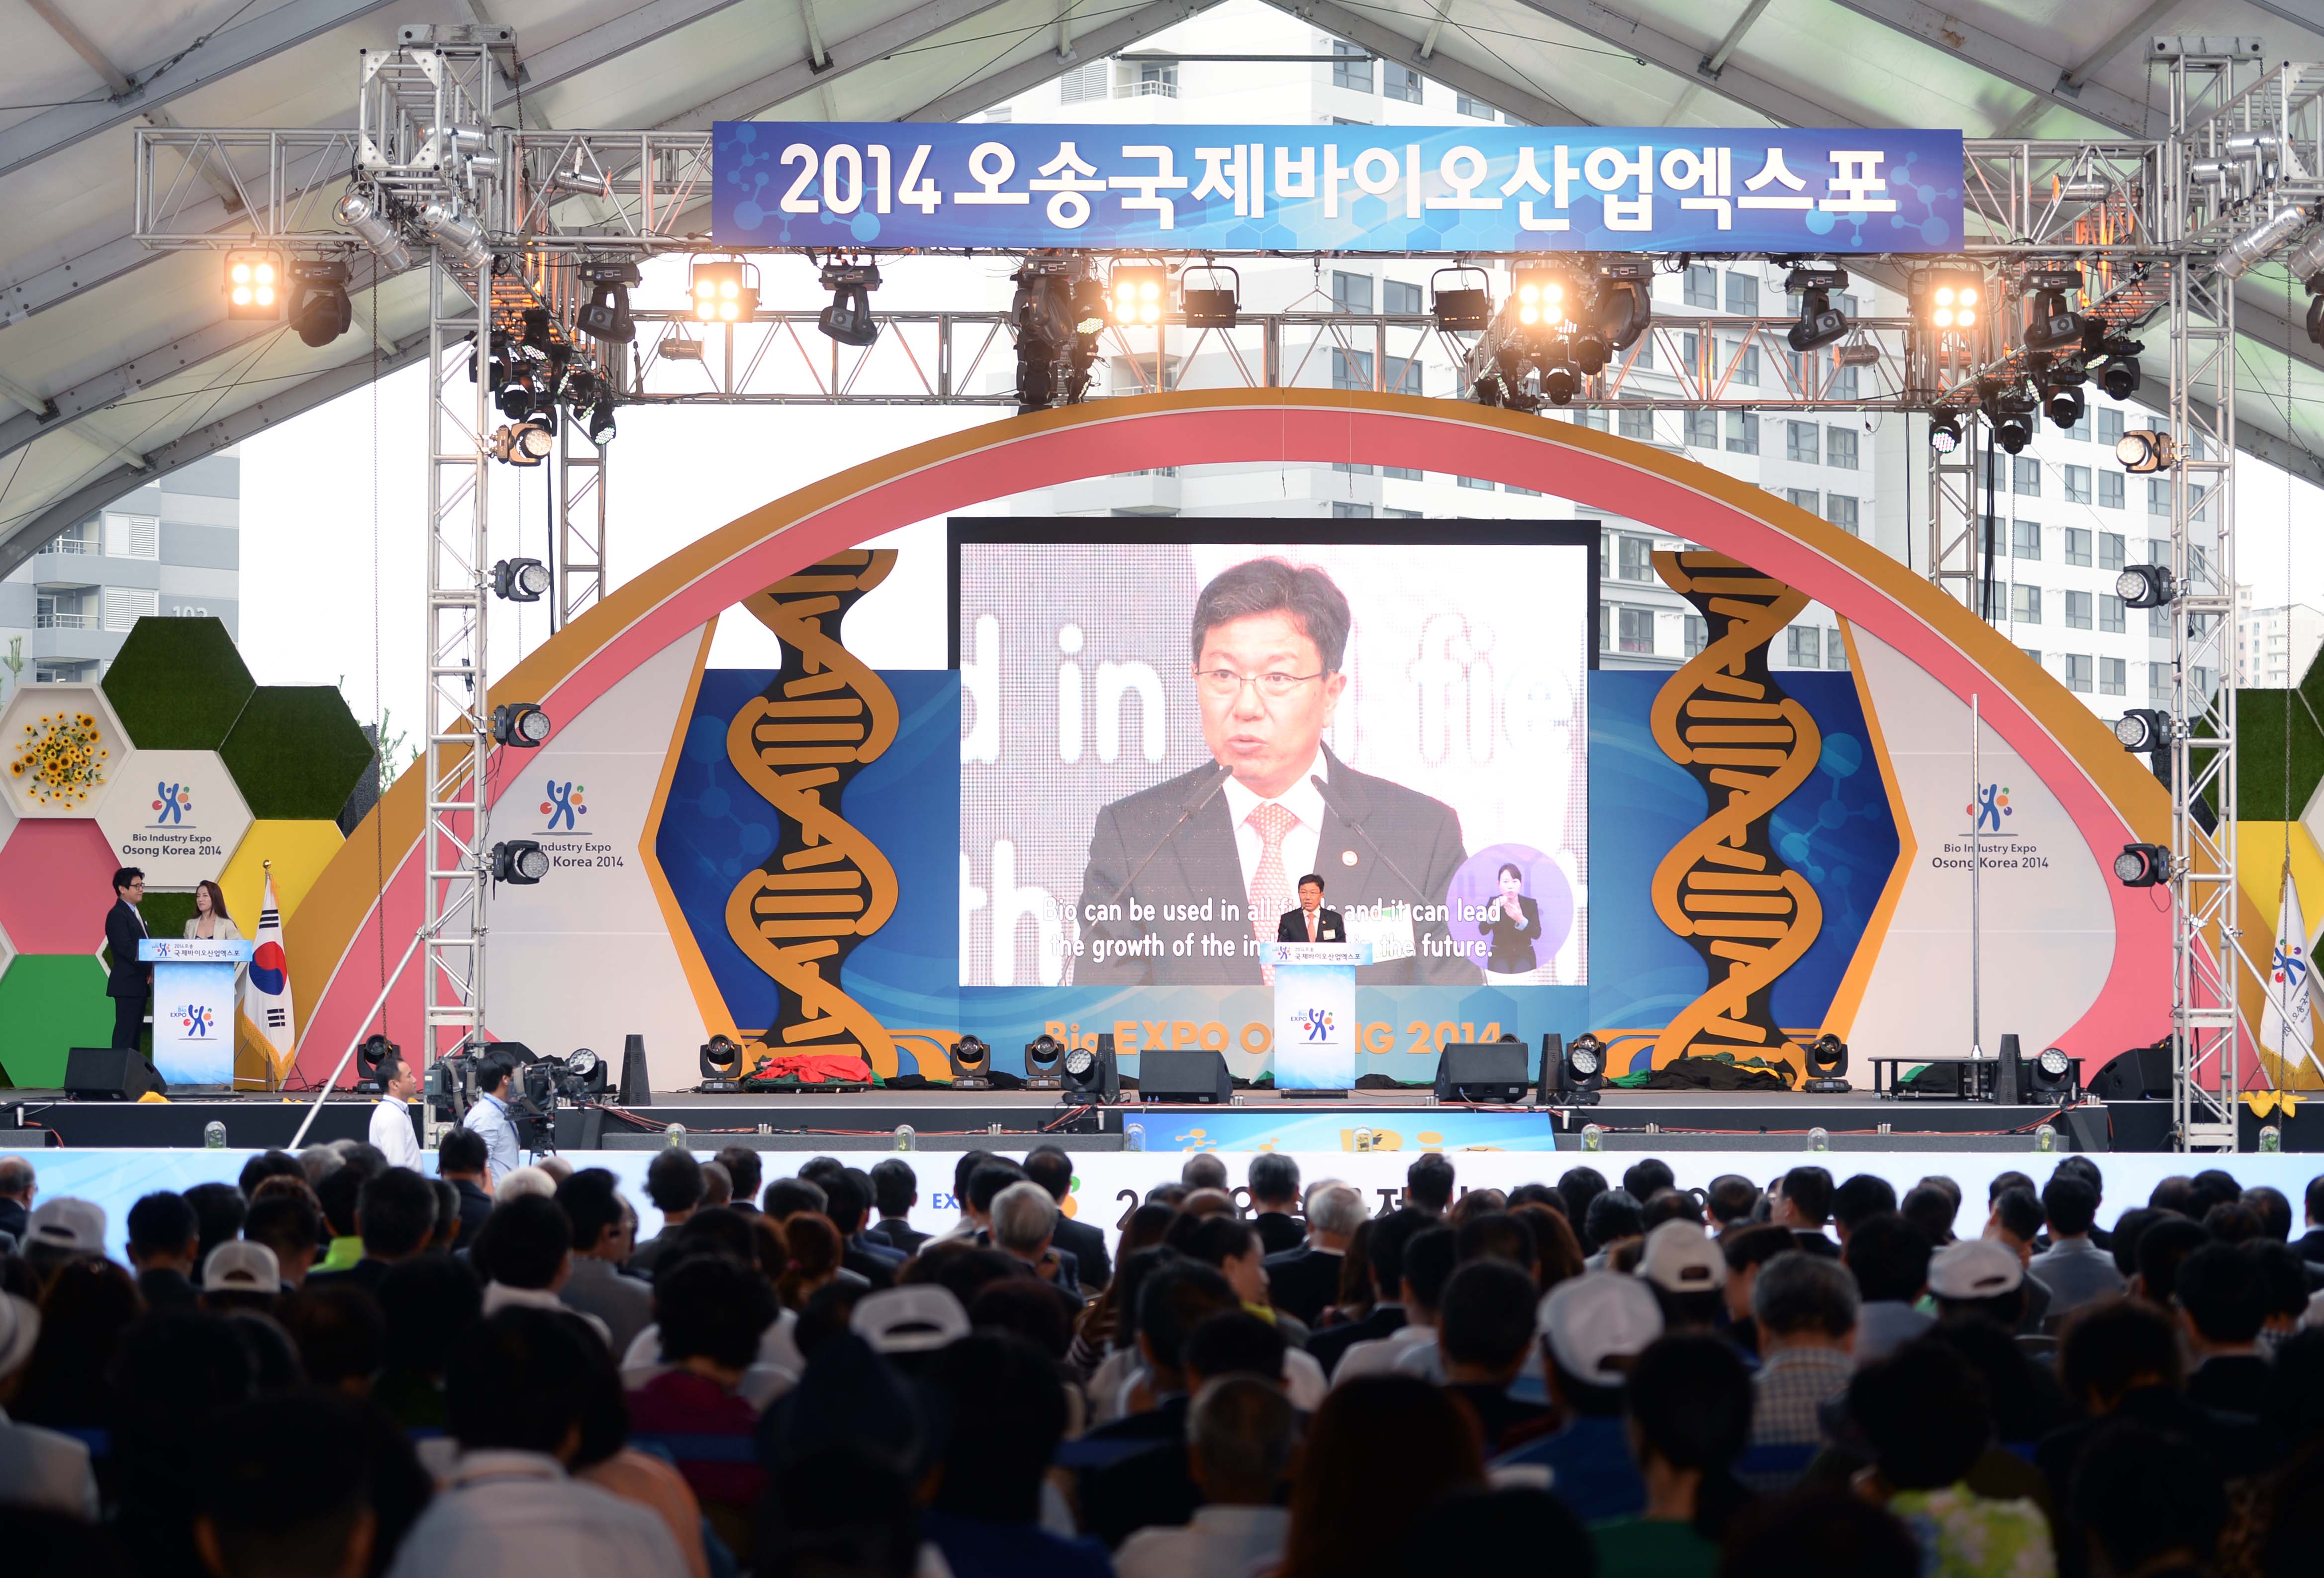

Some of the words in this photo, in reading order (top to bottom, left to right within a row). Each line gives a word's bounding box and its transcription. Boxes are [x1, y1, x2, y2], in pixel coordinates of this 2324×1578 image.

[779, 142, 942, 215] 2014
[954, 141, 1897, 232] 오송국제바이오산업엑스포
[150, 834, 188, 844] Industry
[190, 834, 212, 844] Expo
[122, 845, 160, 857] Osong
[162, 845, 195, 855] Korea
[198, 846, 222, 855] 2014
[540, 842, 582, 854] ndustry
[585, 842, 611, 854] Expo
[1944, 844, 1961, 852] Bio
[2011, 844, 2037, 855] Expo
[553, 856, 592, 867] Korea
[596, 856, 624, 867] 2014
[1980, 857, 2018, 868] Korea
[2022, 857, 2049, 868] 2014
[1043, 896, 1077, 921] Bio
[1084, 903, 1122, 921] can
[1129, 896, 1157, 921] be
[1162, 896, 1213, 921] used
[1221, 898, 1240, 921] in
[1248, 897, 1271, 921] all
[1344, 897, 1383, 921] and
[1390, 898, 1406, 921] it
[1412, 904, 1450, 922] can
[1457, 897, 1501, 922] lead
[1050, 932, 1085, 957] the
[1092, 932, 1165, 963] growth
[1172, 932, 1195, 957] of
[1200, 932, 1236, 957] the
[1380, 933, 1416, 958] the
[1421, 932, 1493, 958] future.
[1113, 1021, 1230, 1055] EXPO
[1406, 1021, 1500, 1054] 2014
